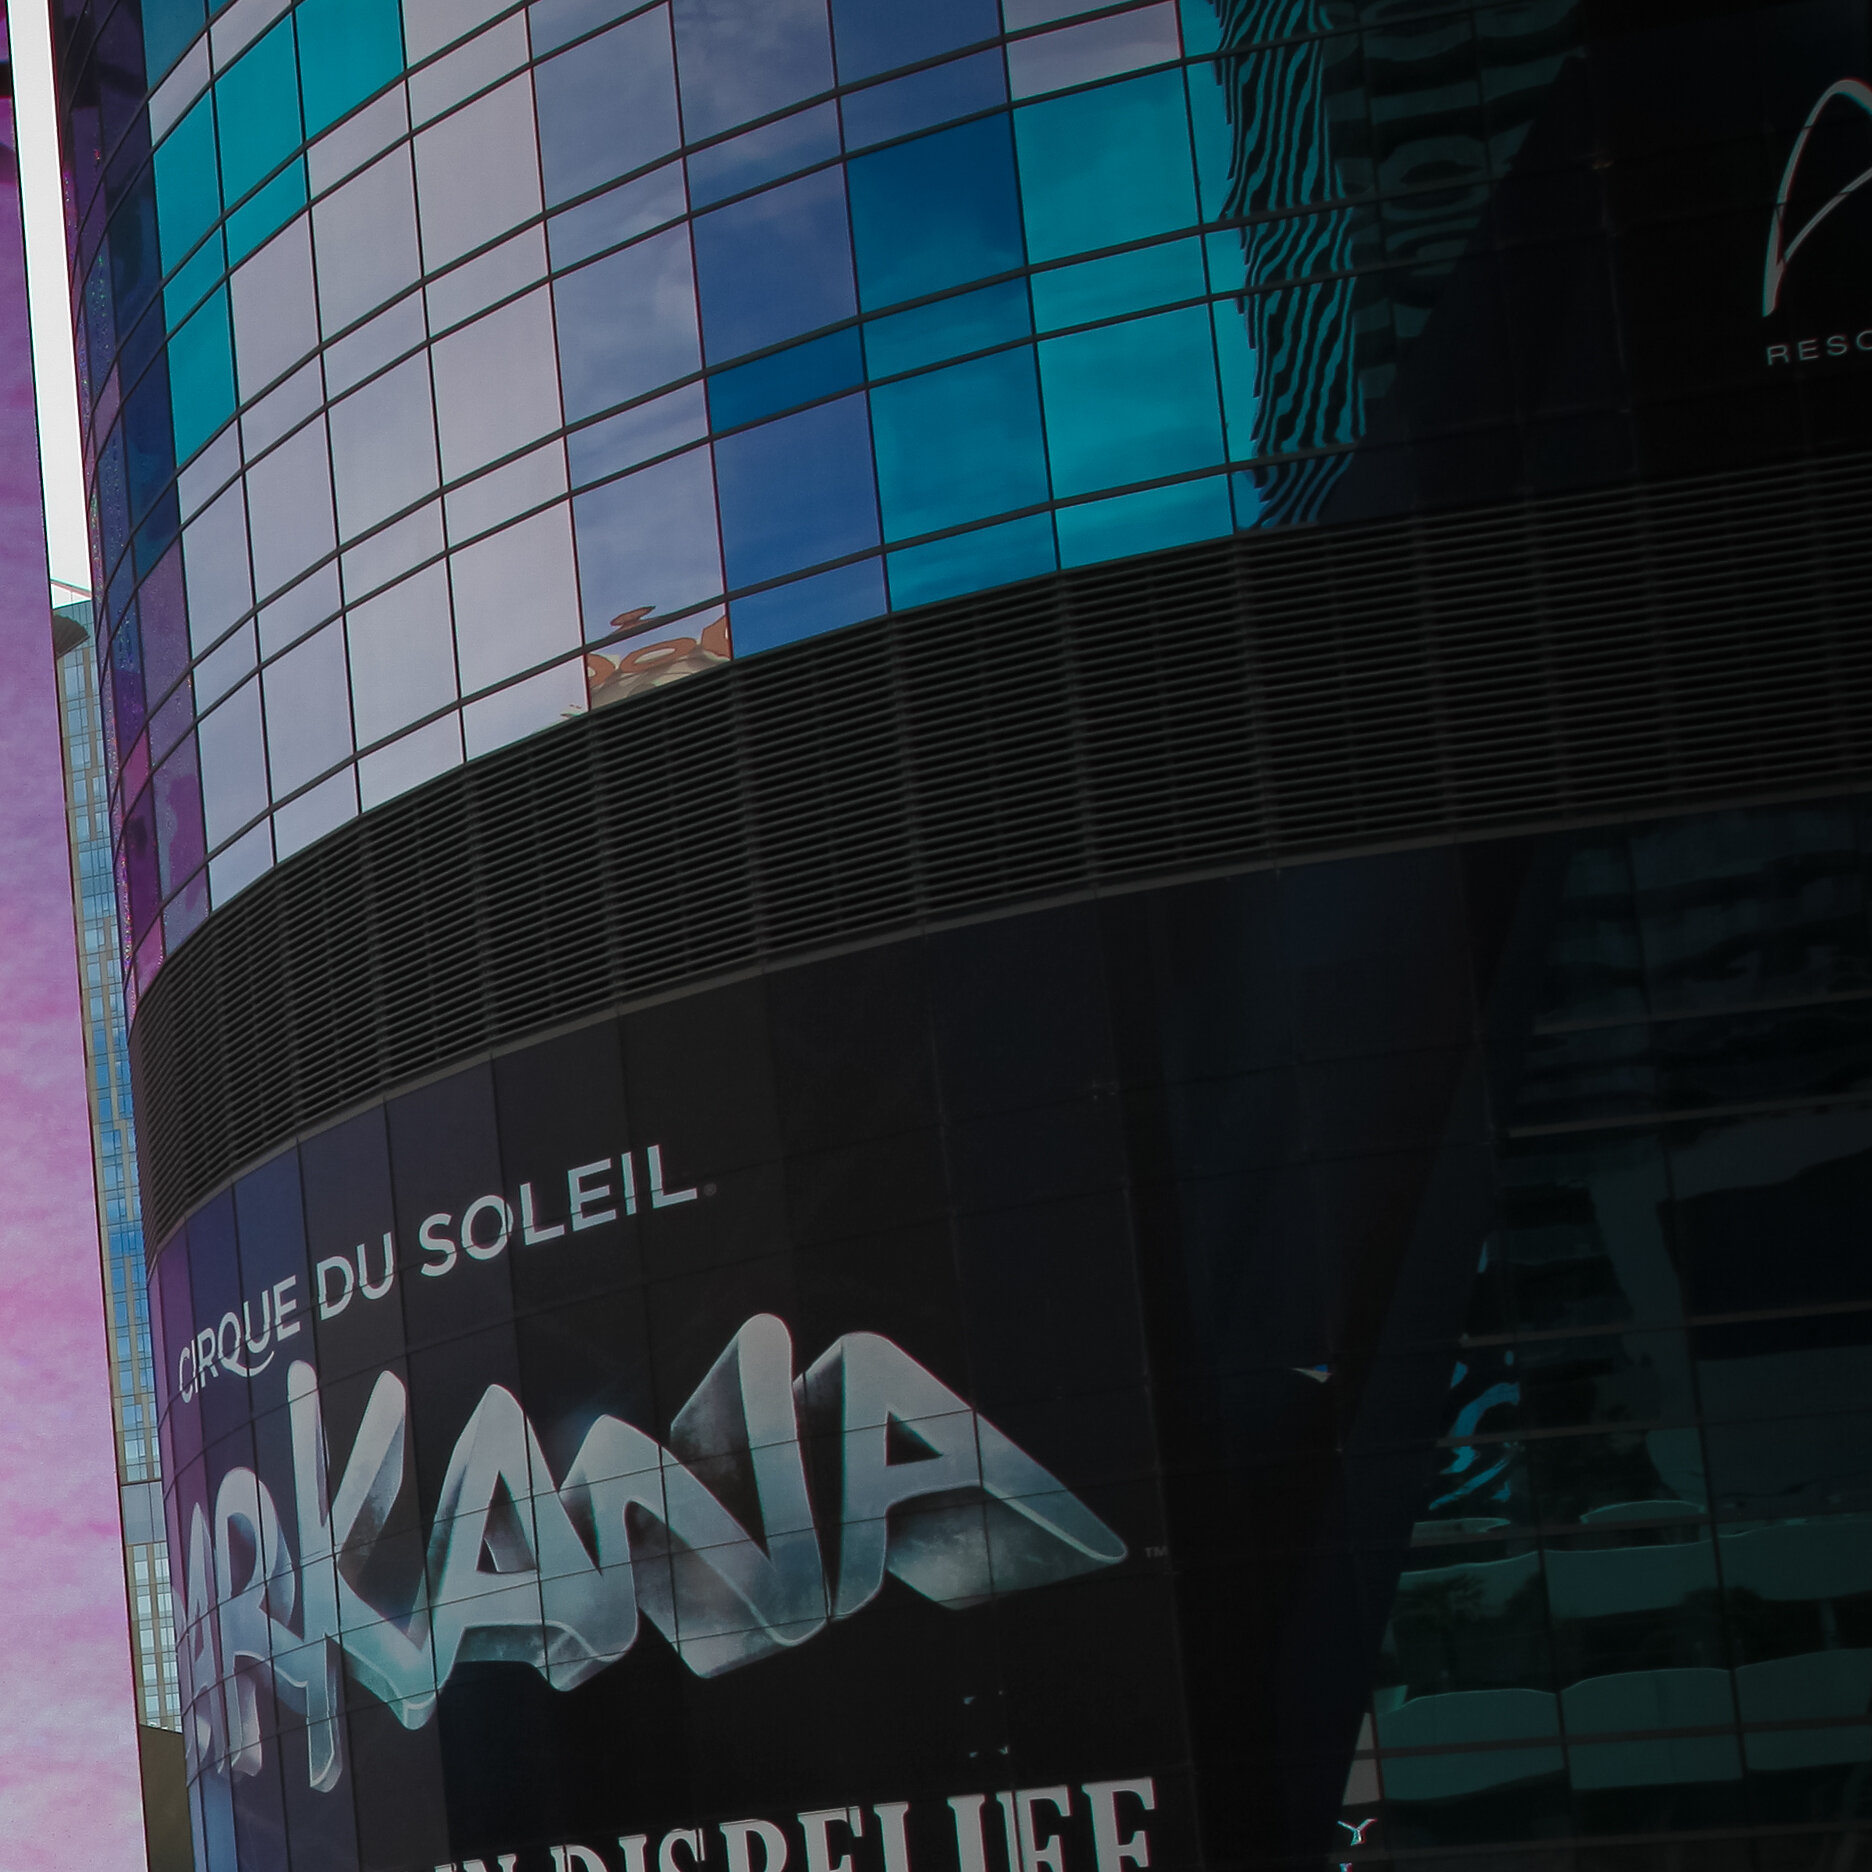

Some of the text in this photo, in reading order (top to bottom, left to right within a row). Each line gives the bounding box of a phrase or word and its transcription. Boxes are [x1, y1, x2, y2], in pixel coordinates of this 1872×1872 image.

[179, 1145, 698, 1403] CIRQUE DU SOLEIL
[180, 1312, 1128, 1792] ARKANA
